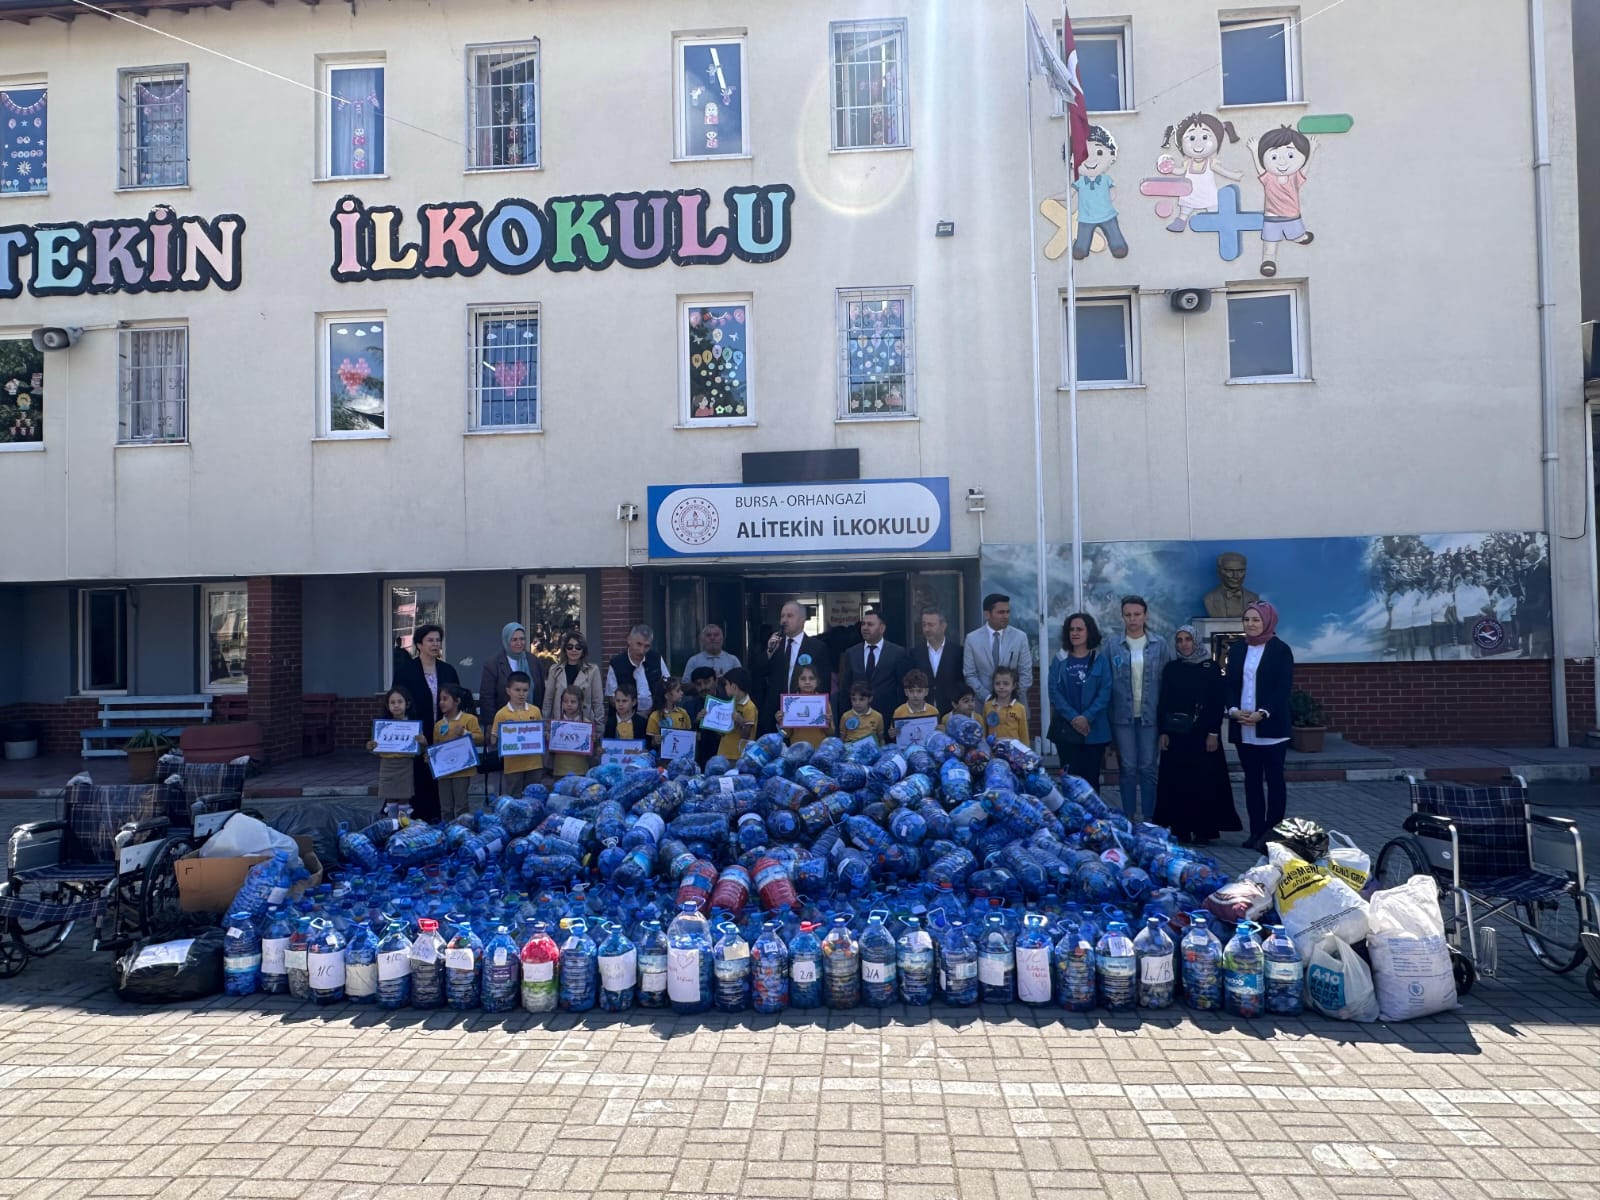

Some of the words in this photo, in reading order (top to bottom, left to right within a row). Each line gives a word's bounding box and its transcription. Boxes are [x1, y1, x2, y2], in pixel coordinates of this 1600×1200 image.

[332, 186, 793, 281] İLKOKULU
[735, 496, 778, 509] BURSA
[787, 491, 867, 507] ORHANGAZİ
[736, 517, 824, 539] ALİTEKİN
[833, 515, 931, 537] İLKOKULU
